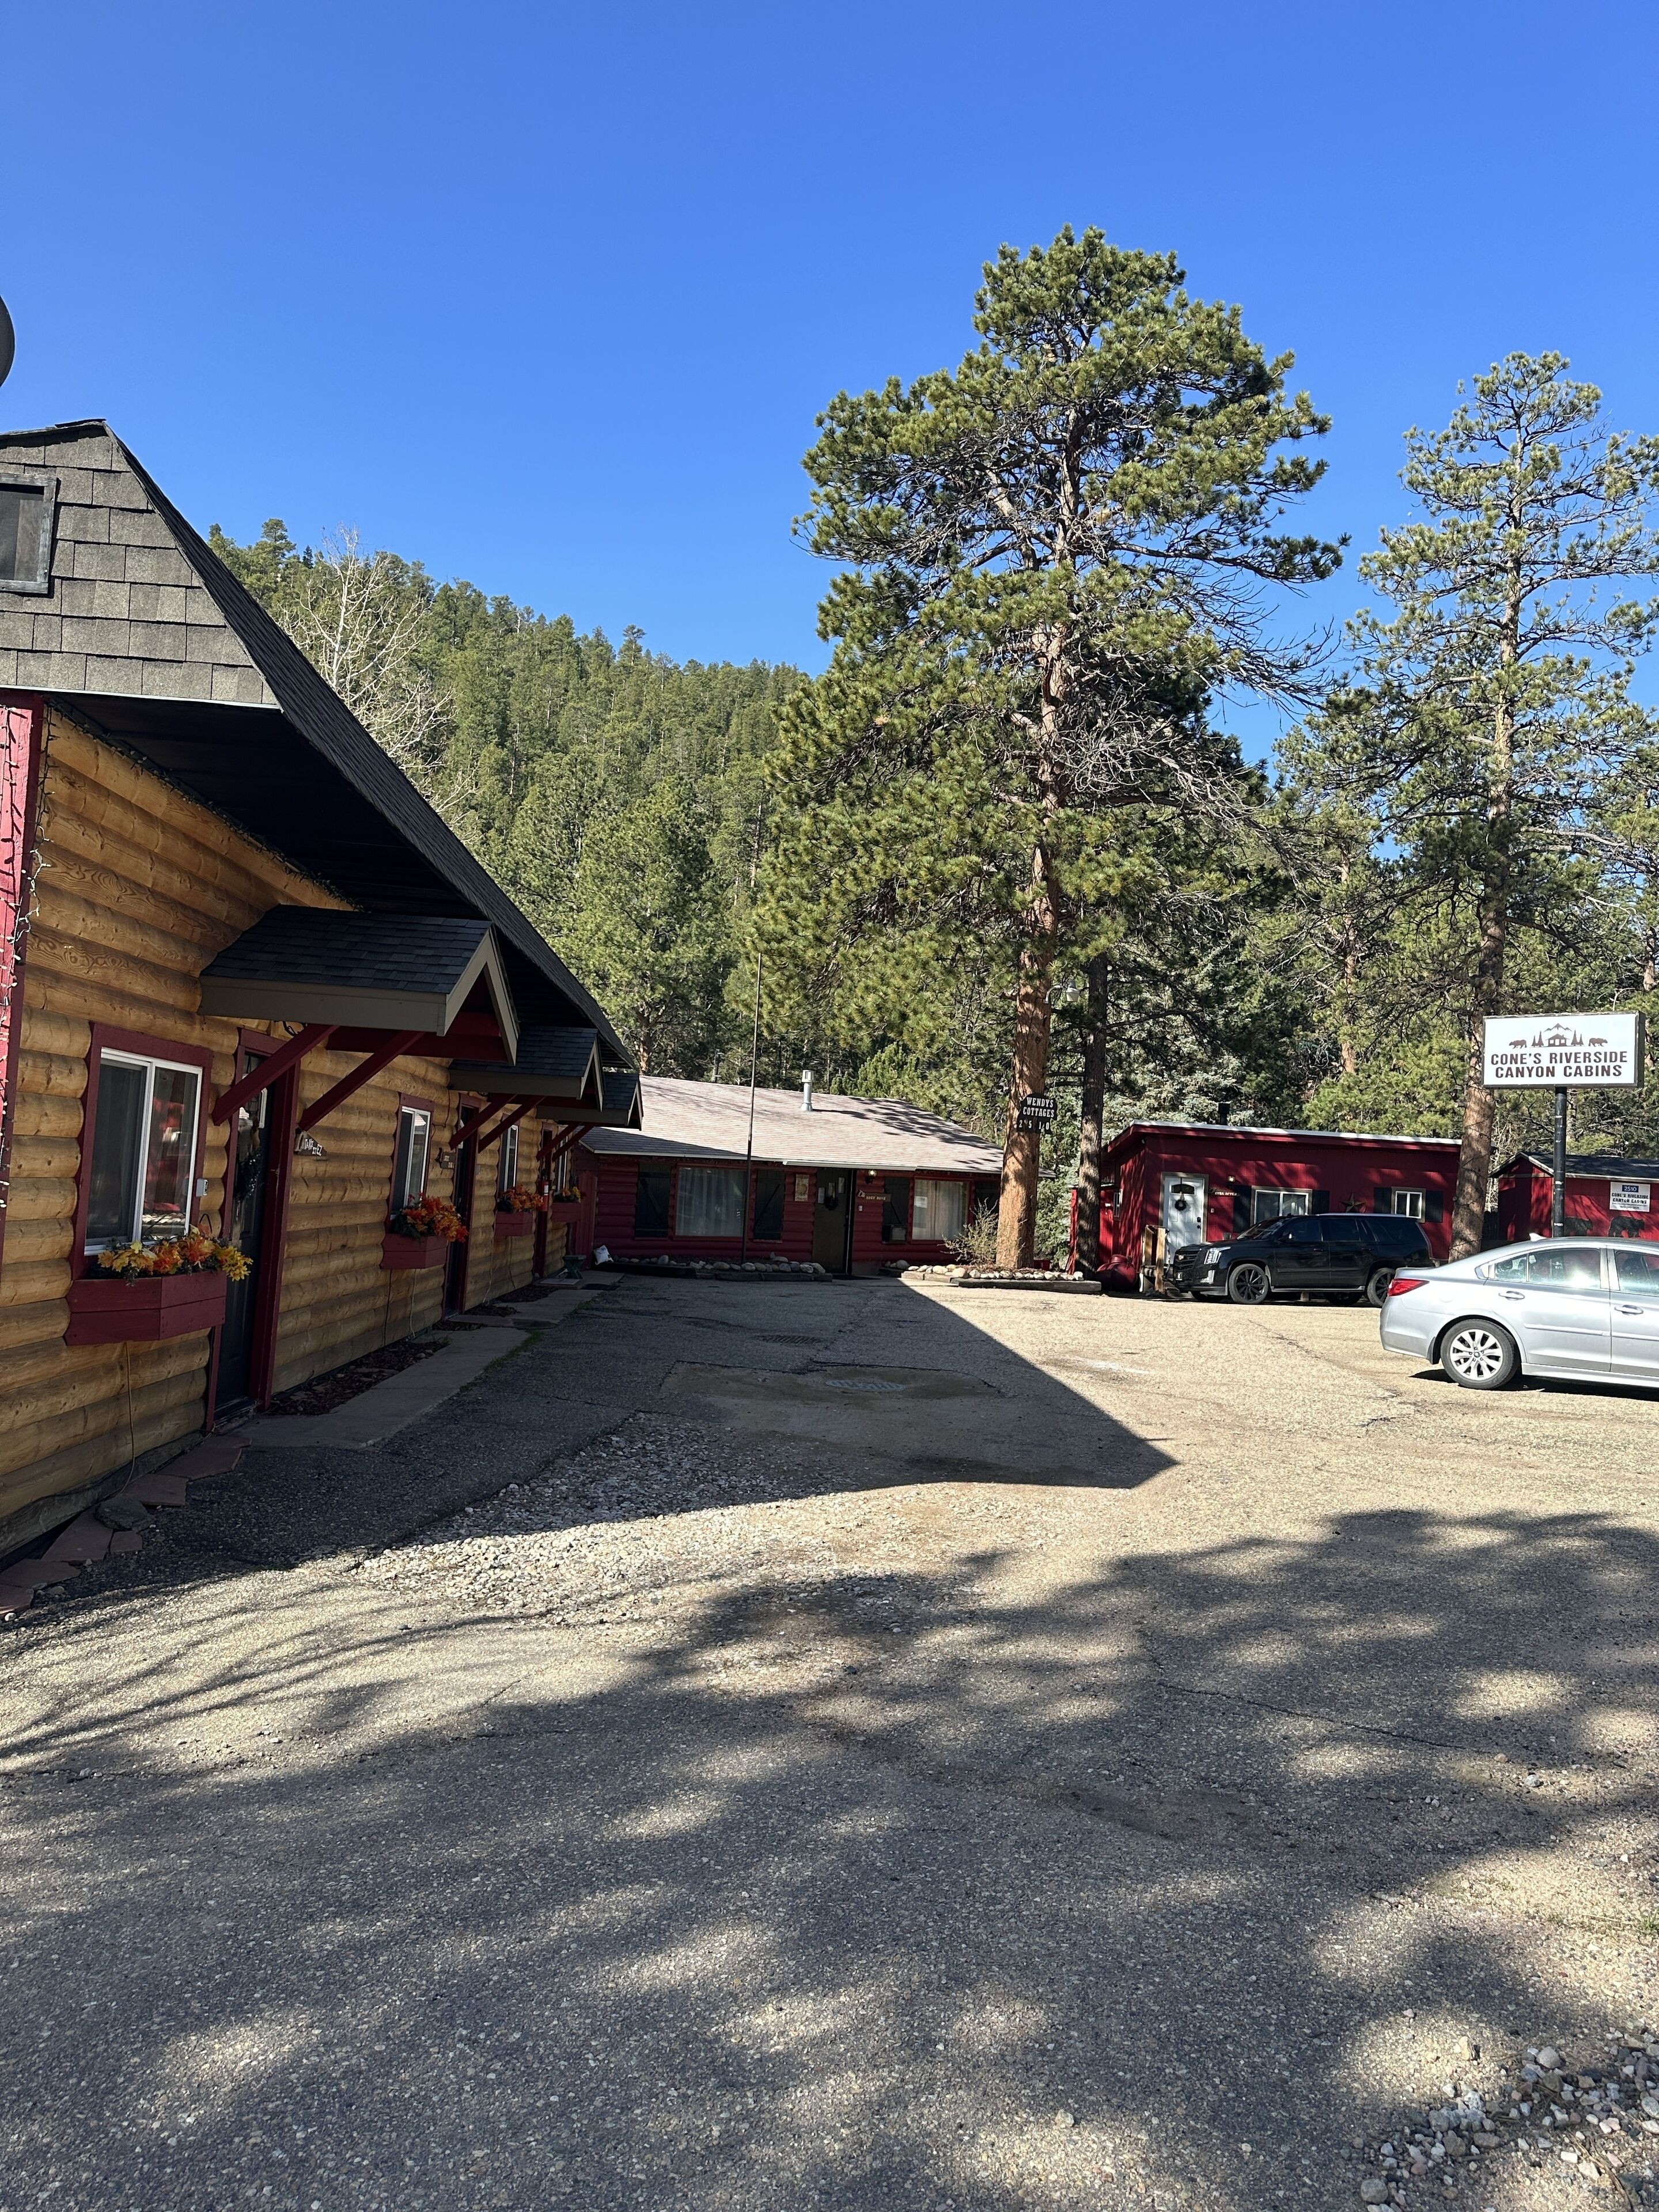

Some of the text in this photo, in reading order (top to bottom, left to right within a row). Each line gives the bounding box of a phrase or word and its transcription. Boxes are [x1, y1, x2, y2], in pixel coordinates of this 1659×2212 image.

[1491, 1051, 1627, 1065] CONE'S RIVERSIDE
[1495, 1065, 1622, 1078] CANYON CABINS
[1027, 1097, 1054, 1108] WENDYS
[1023, 1107, 1055, 1118] COTTAGES
